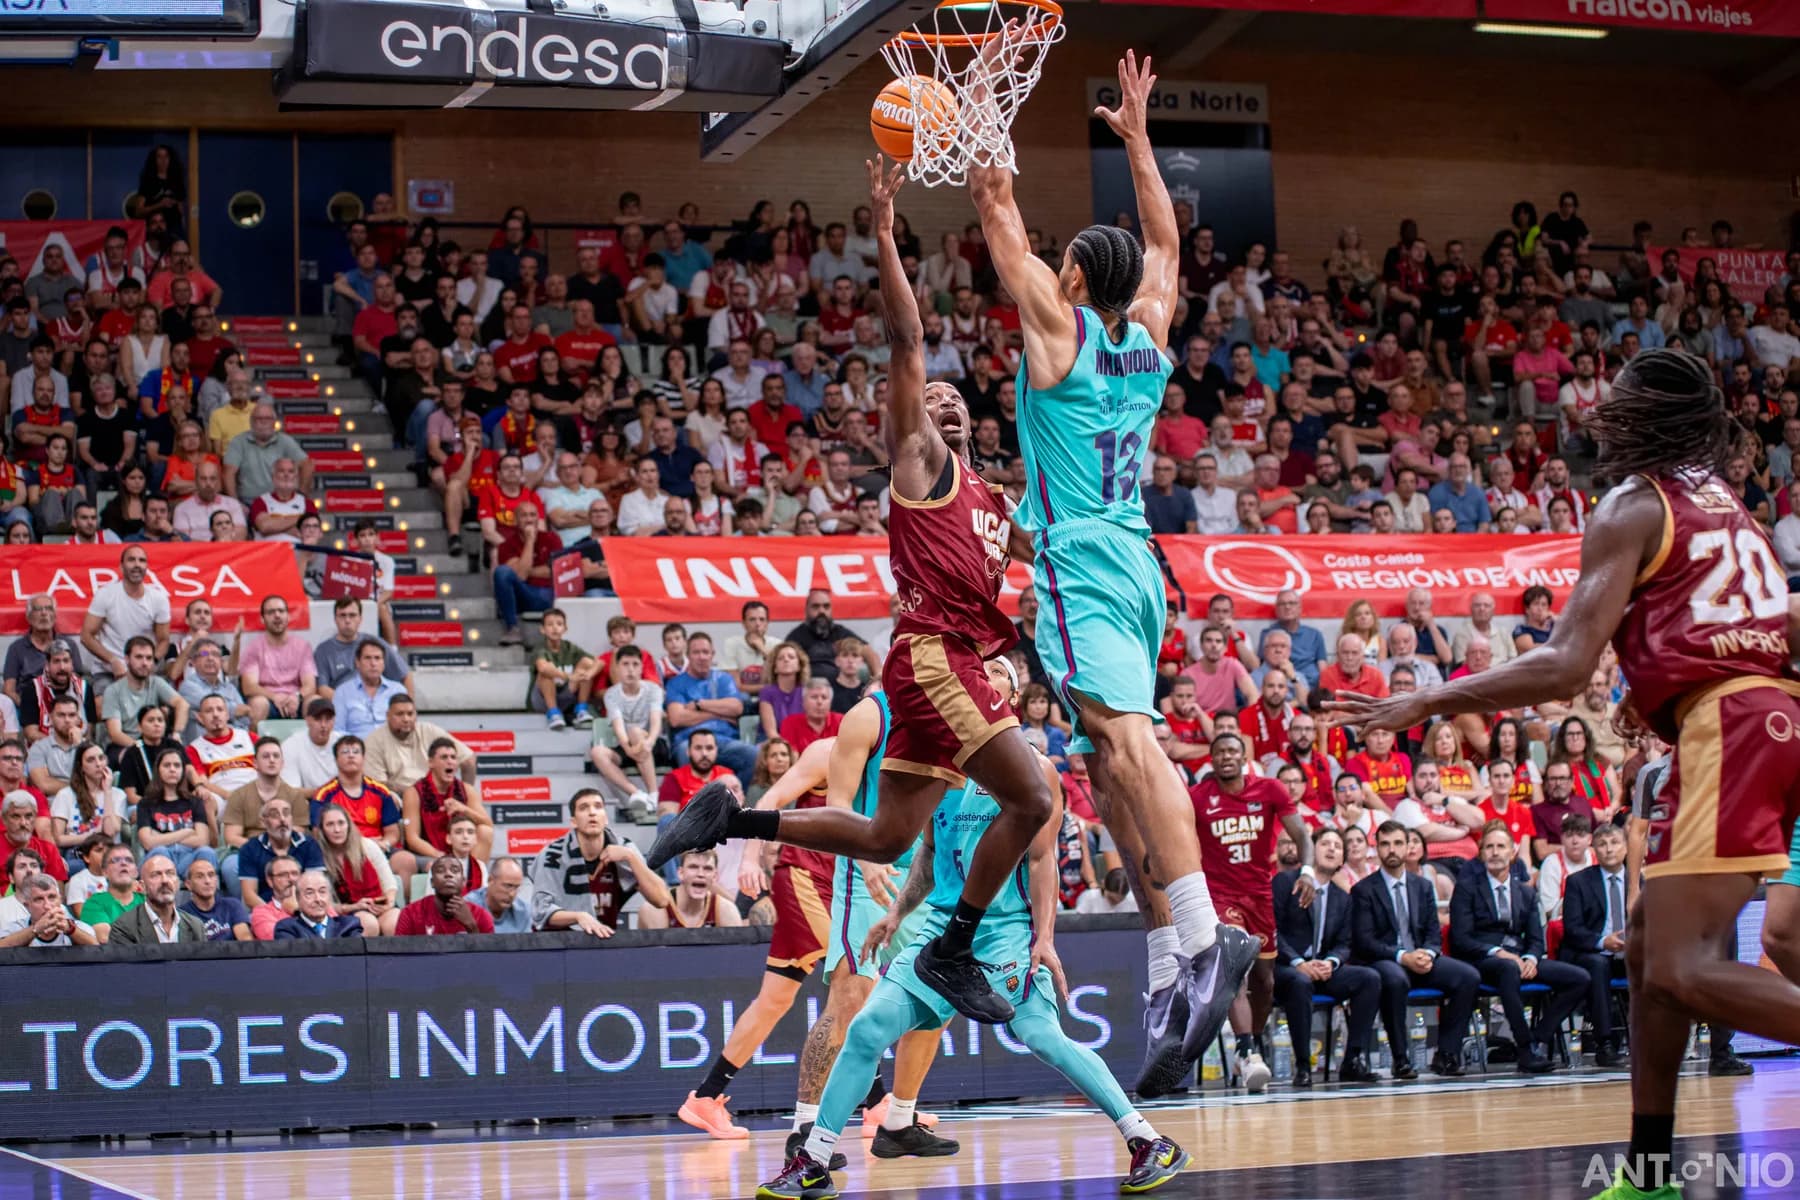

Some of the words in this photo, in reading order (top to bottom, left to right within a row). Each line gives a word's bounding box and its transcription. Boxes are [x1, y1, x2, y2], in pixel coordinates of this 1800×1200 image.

[1695, 5, 1753, 28] viajes
[381, 17, 669, 90] endesa
[1096, 87, 1179, 110] Gda
[1190, 90, 1259, 112] Norte
[1717, 252, 1784, 269] PUNTA
[1717, 268, 1788, 286] ALER
[1094, 430, 1143, 506] 13
[971, 508, 1011, 552] UCA
[1323, 553, 1371, 568] Costa
[655, 554, 900, 599] INVE
[1331, 566, 1460, 590] REGIÓN
[1464, 566, 1510, 589] DE
[1512, 567, 1581, 589] MUR
[1688, 527, 1789, 625] 20
[1210, 815, 1265, 838] UCAM
[1220, 831, 1259, 846] MURCIA
[1227, 843, 1253, 865] 31
[0, 1012, 348, 1092] TORES
